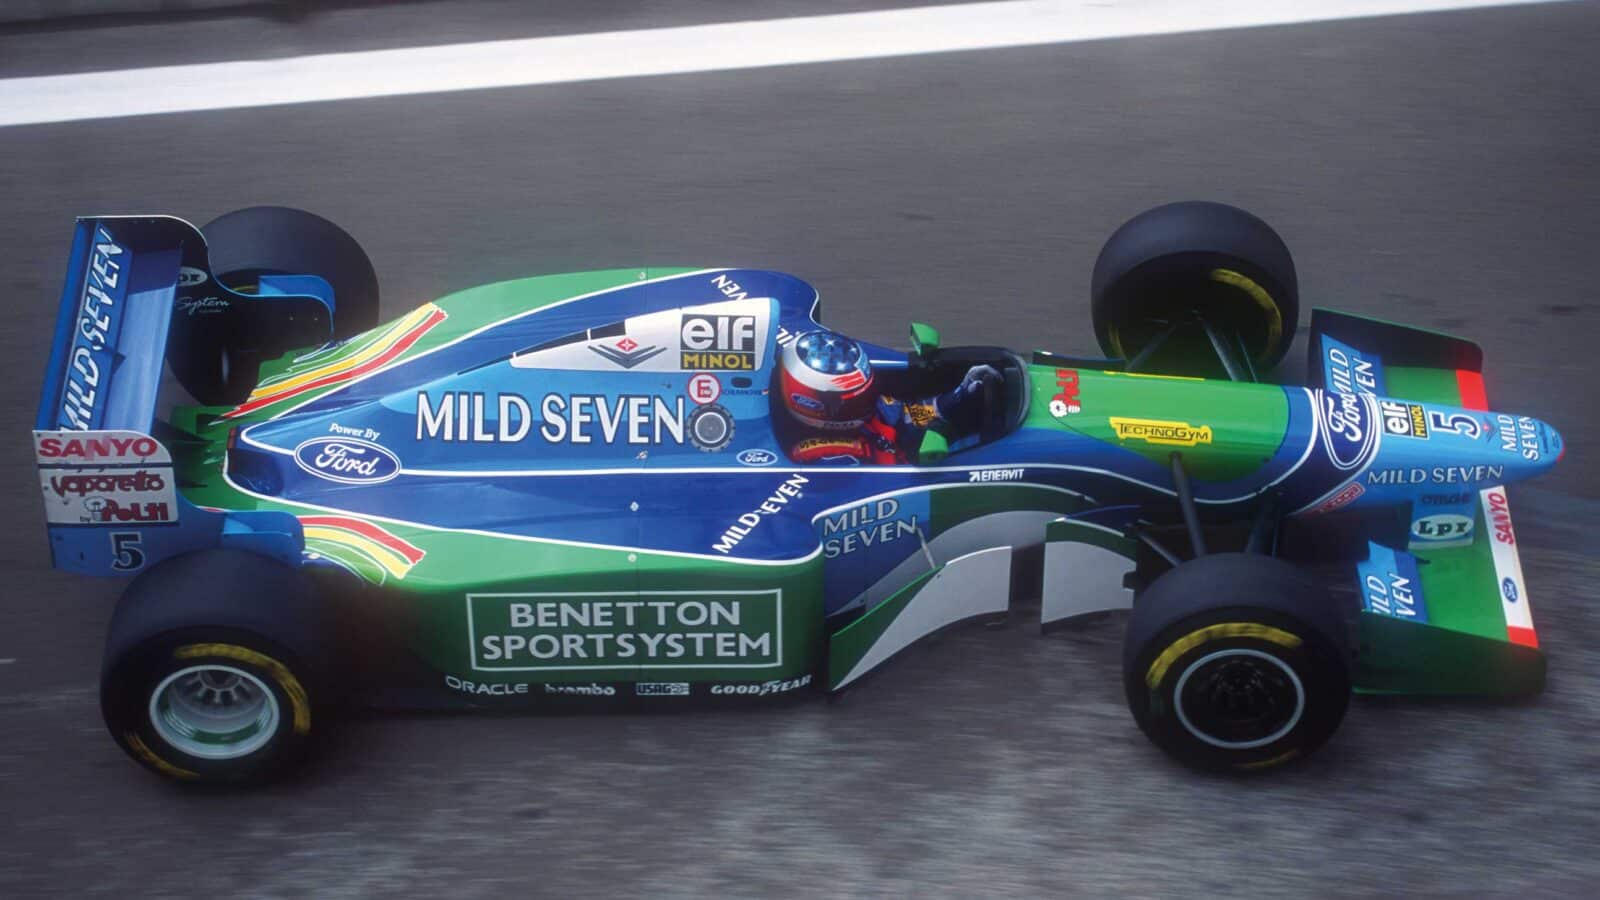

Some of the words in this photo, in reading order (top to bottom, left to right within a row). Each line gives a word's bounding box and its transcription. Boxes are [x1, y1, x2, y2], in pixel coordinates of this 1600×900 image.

[80, 228, 123, 350] SEVEN
[711, 274, 748, 301] VEN
[682, 316, 755, 350] elf
[683, 353, 753, 369] MINOL
[329, 422, 365, 437] Power
[416, 391, 532, 443] MILD
[540, 394, 685, 446] SEVEN
[1381, 401, 1409, 434] elf
[1428, 411, 1481, 440] 5
[1497, 414, 1517, 452] MILD
[38, 437, 159, 459] SANYO
[314, 442, 380, 477] Ford
[744, 451, 770, 464] Ford
[51, 470, 166, 497] vaporetto
[1367, 466, 1428, 485] MILD
[1431, 464, 1505, 484] SEVEN
[712, 512, 761, 554] MILD
[823, 498, 899, 537] MILD
[1487, 492, 1515, 545] SANYO
[111, 531, 147, 572] 5
[823, 516, 919, 559] SEVEN
[1367, 575, 1391, 614] ILD
[1389, 572, 1417, 617] VEN
[509, 601, 741, 629] BENETTON
[482, 631, 772, 661] SPORTSYSTEM
[445, 674, 529, 696] ORACLE
[545, 683, 616, 696] brembo
[710, 674, 813, 697] GOODYEAR
